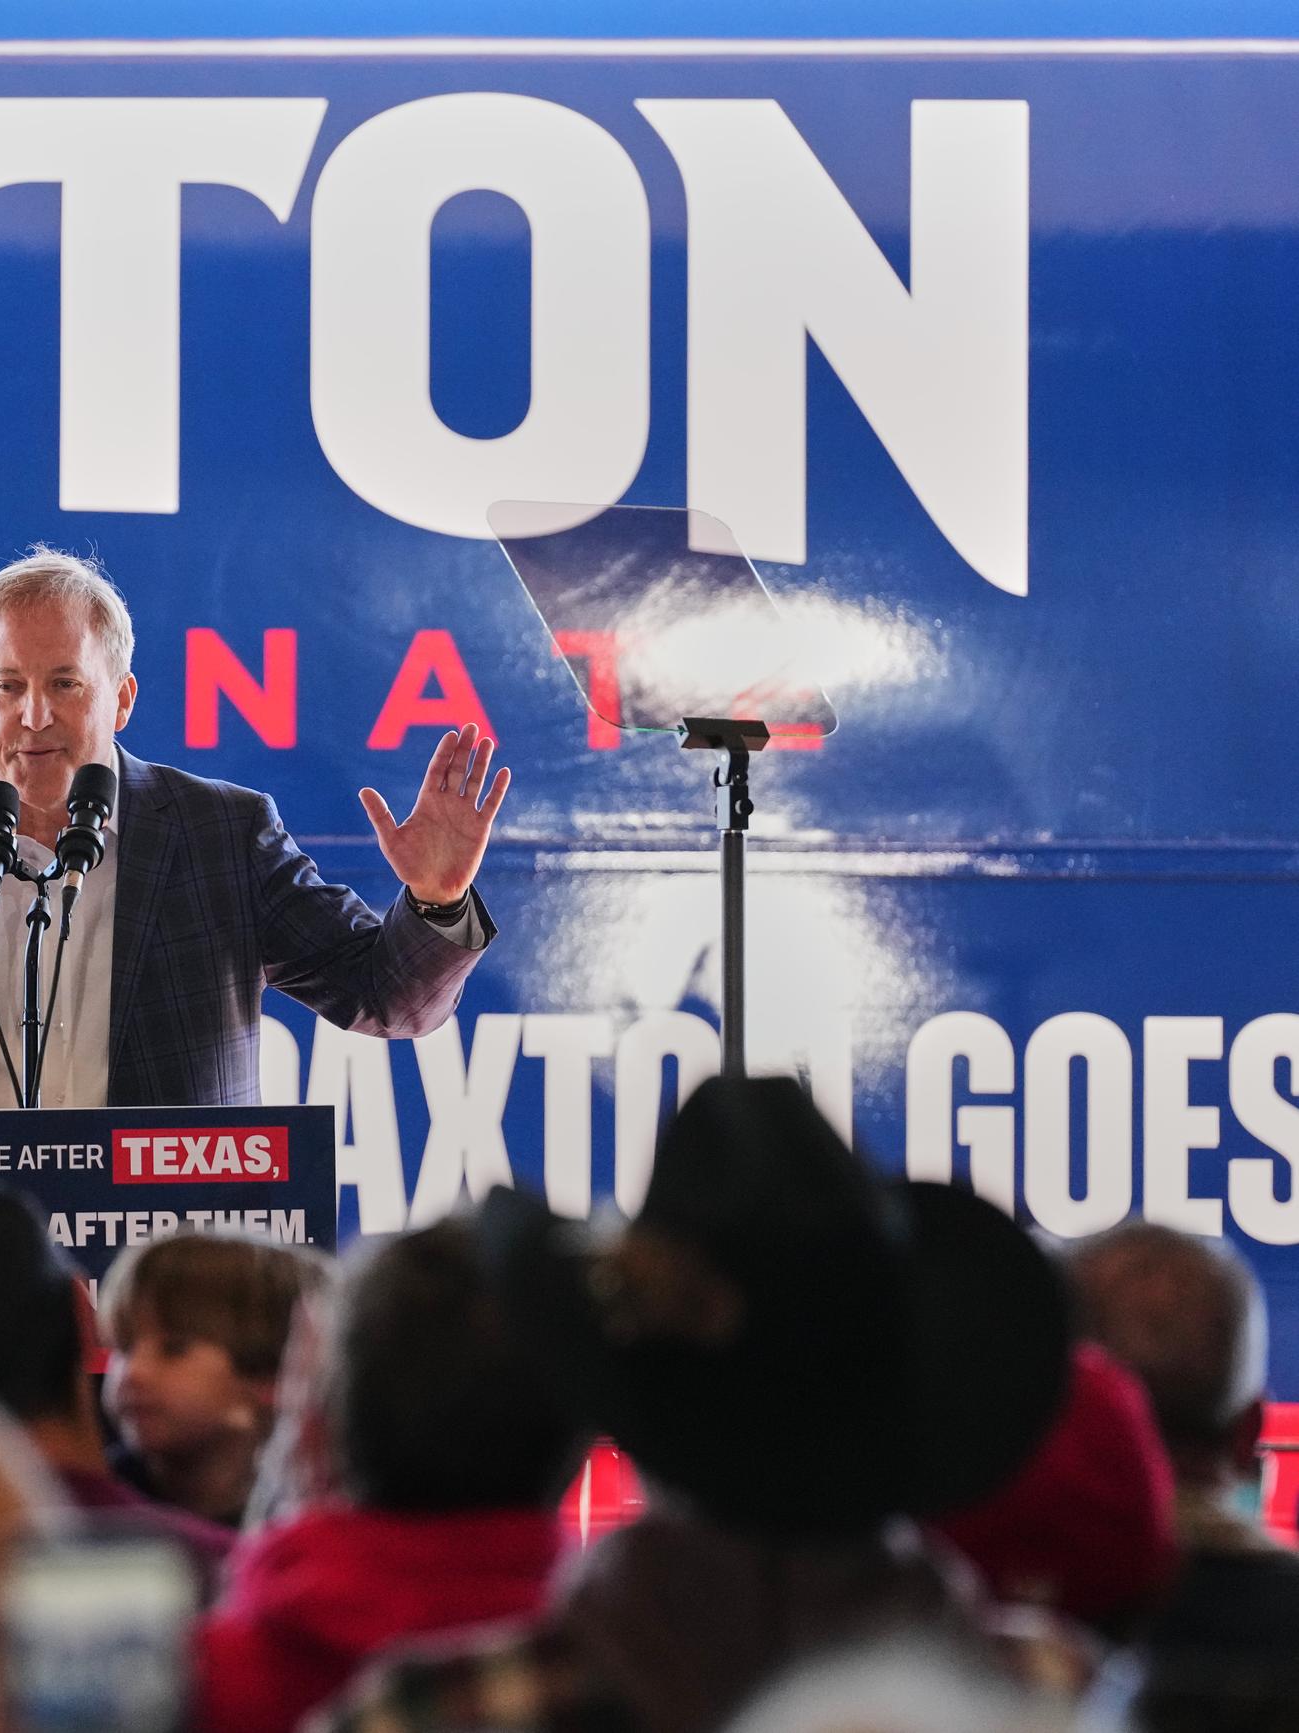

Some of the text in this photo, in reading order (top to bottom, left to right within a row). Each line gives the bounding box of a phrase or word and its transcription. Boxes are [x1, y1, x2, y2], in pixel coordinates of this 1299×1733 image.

[905, 1010, 1299, 1246] GOES
[17, 1143, 105, 1171] AFTER
[120, 1134, 281, 1179] TEXAS,
[46, 1210, 179, 1248] AFTER
